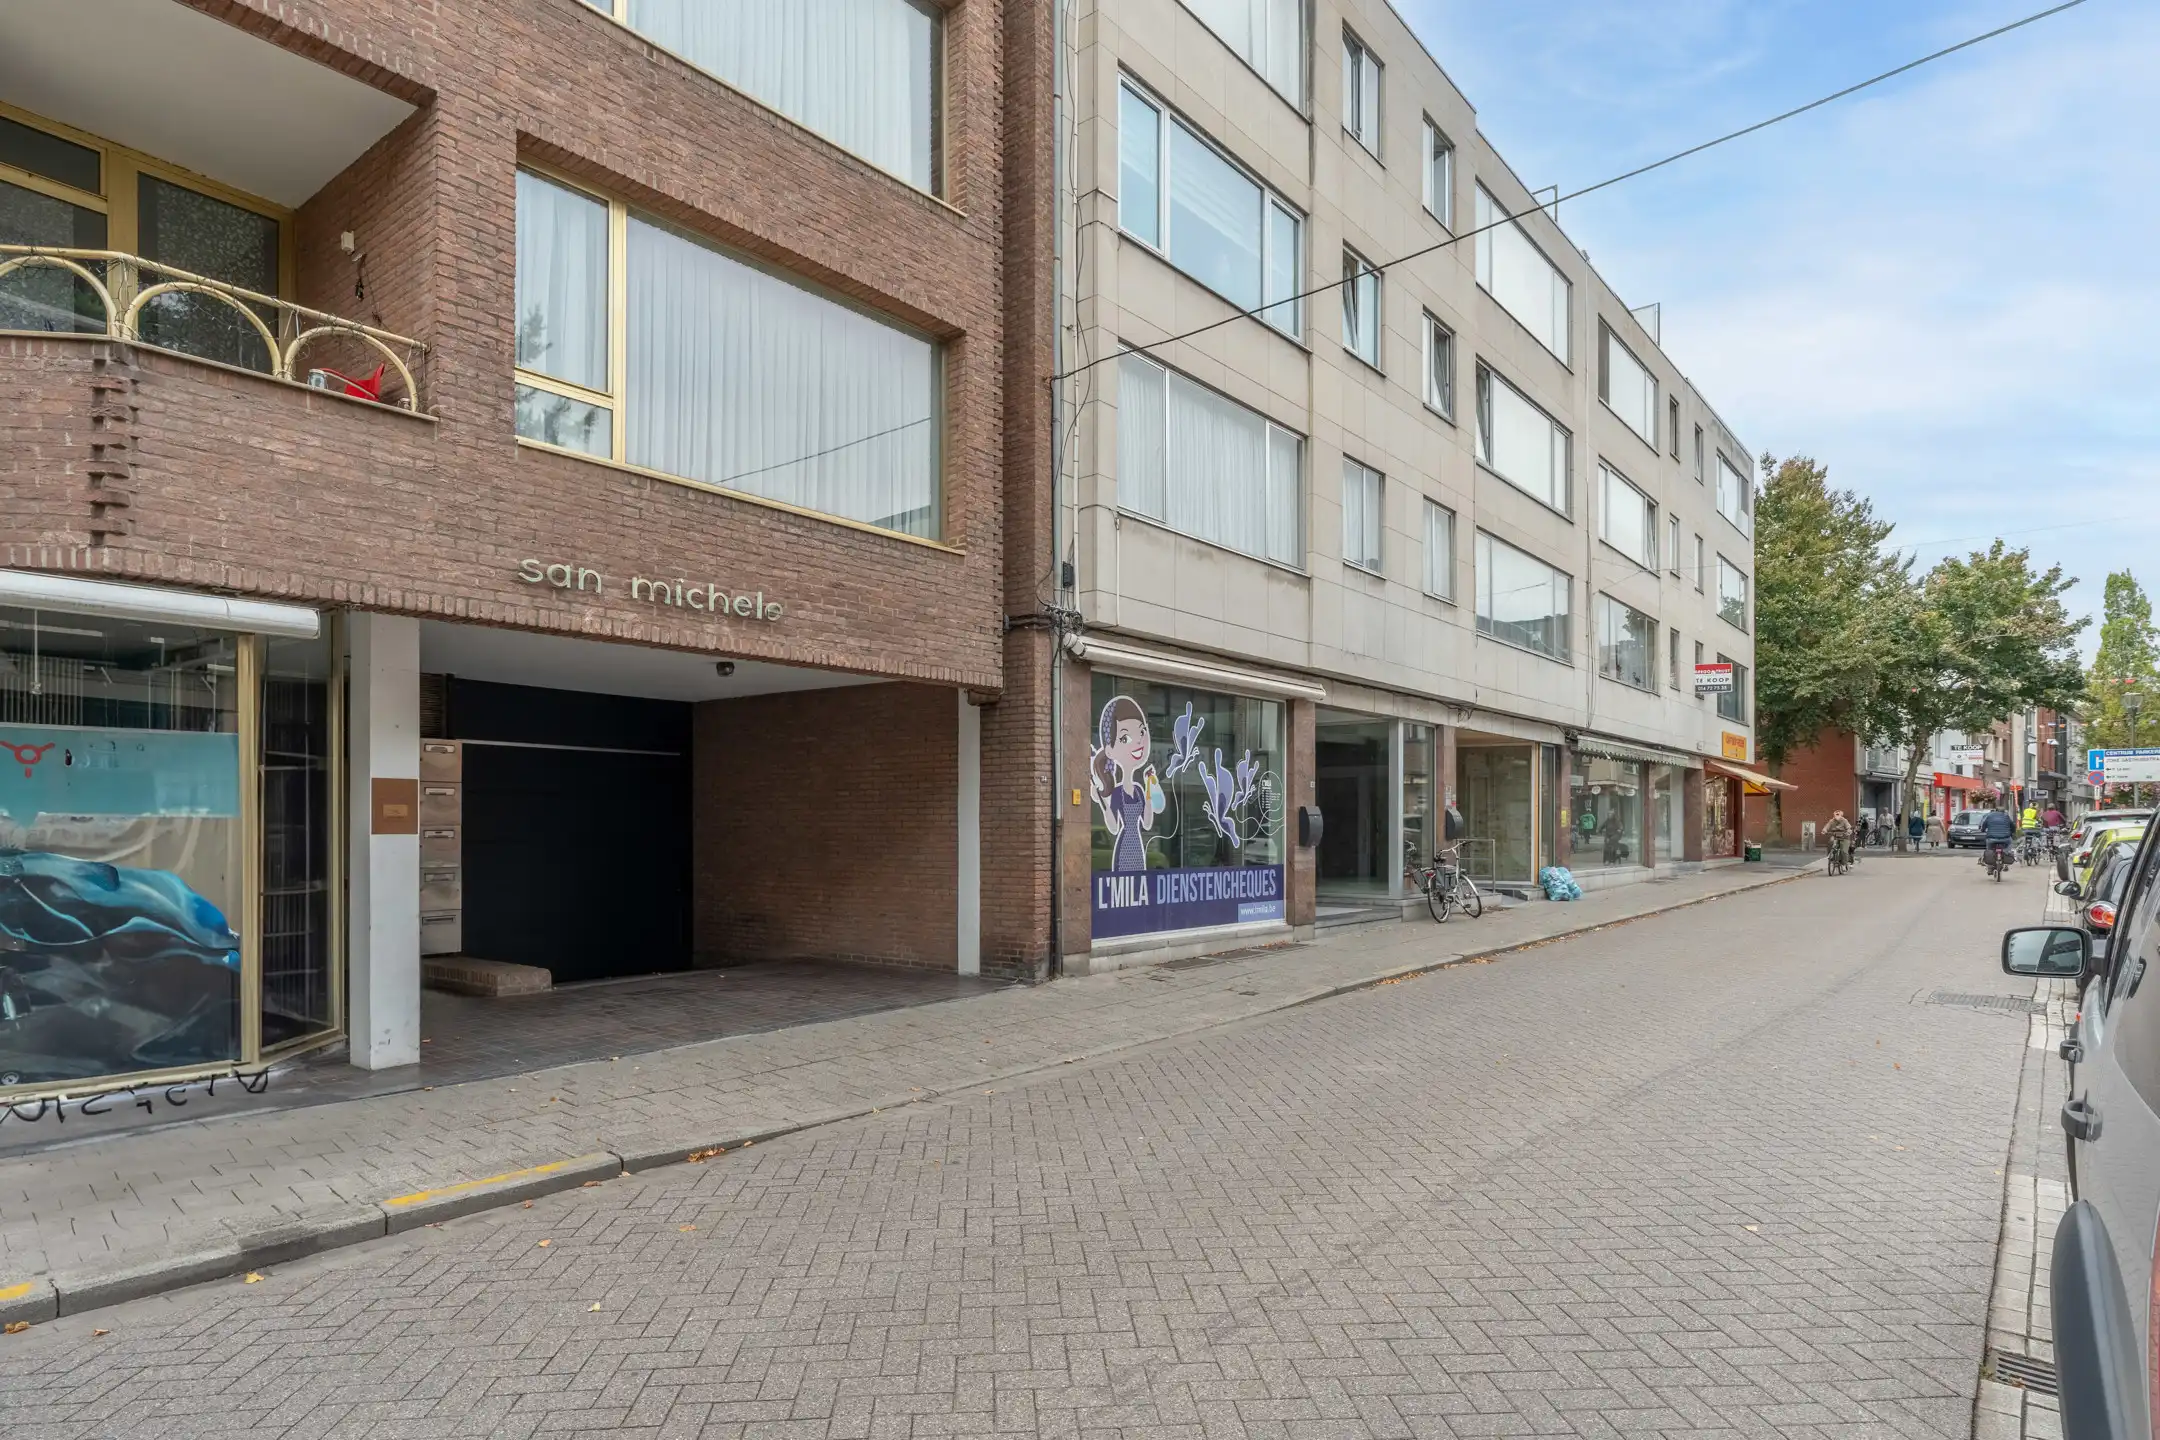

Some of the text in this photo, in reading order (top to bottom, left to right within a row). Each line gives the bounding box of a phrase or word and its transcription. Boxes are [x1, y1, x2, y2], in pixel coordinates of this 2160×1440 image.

[517, 558, 784, 621] san michele
[1098, 868, 1277, 910] L'MILA DIENSTENCHEQUES
